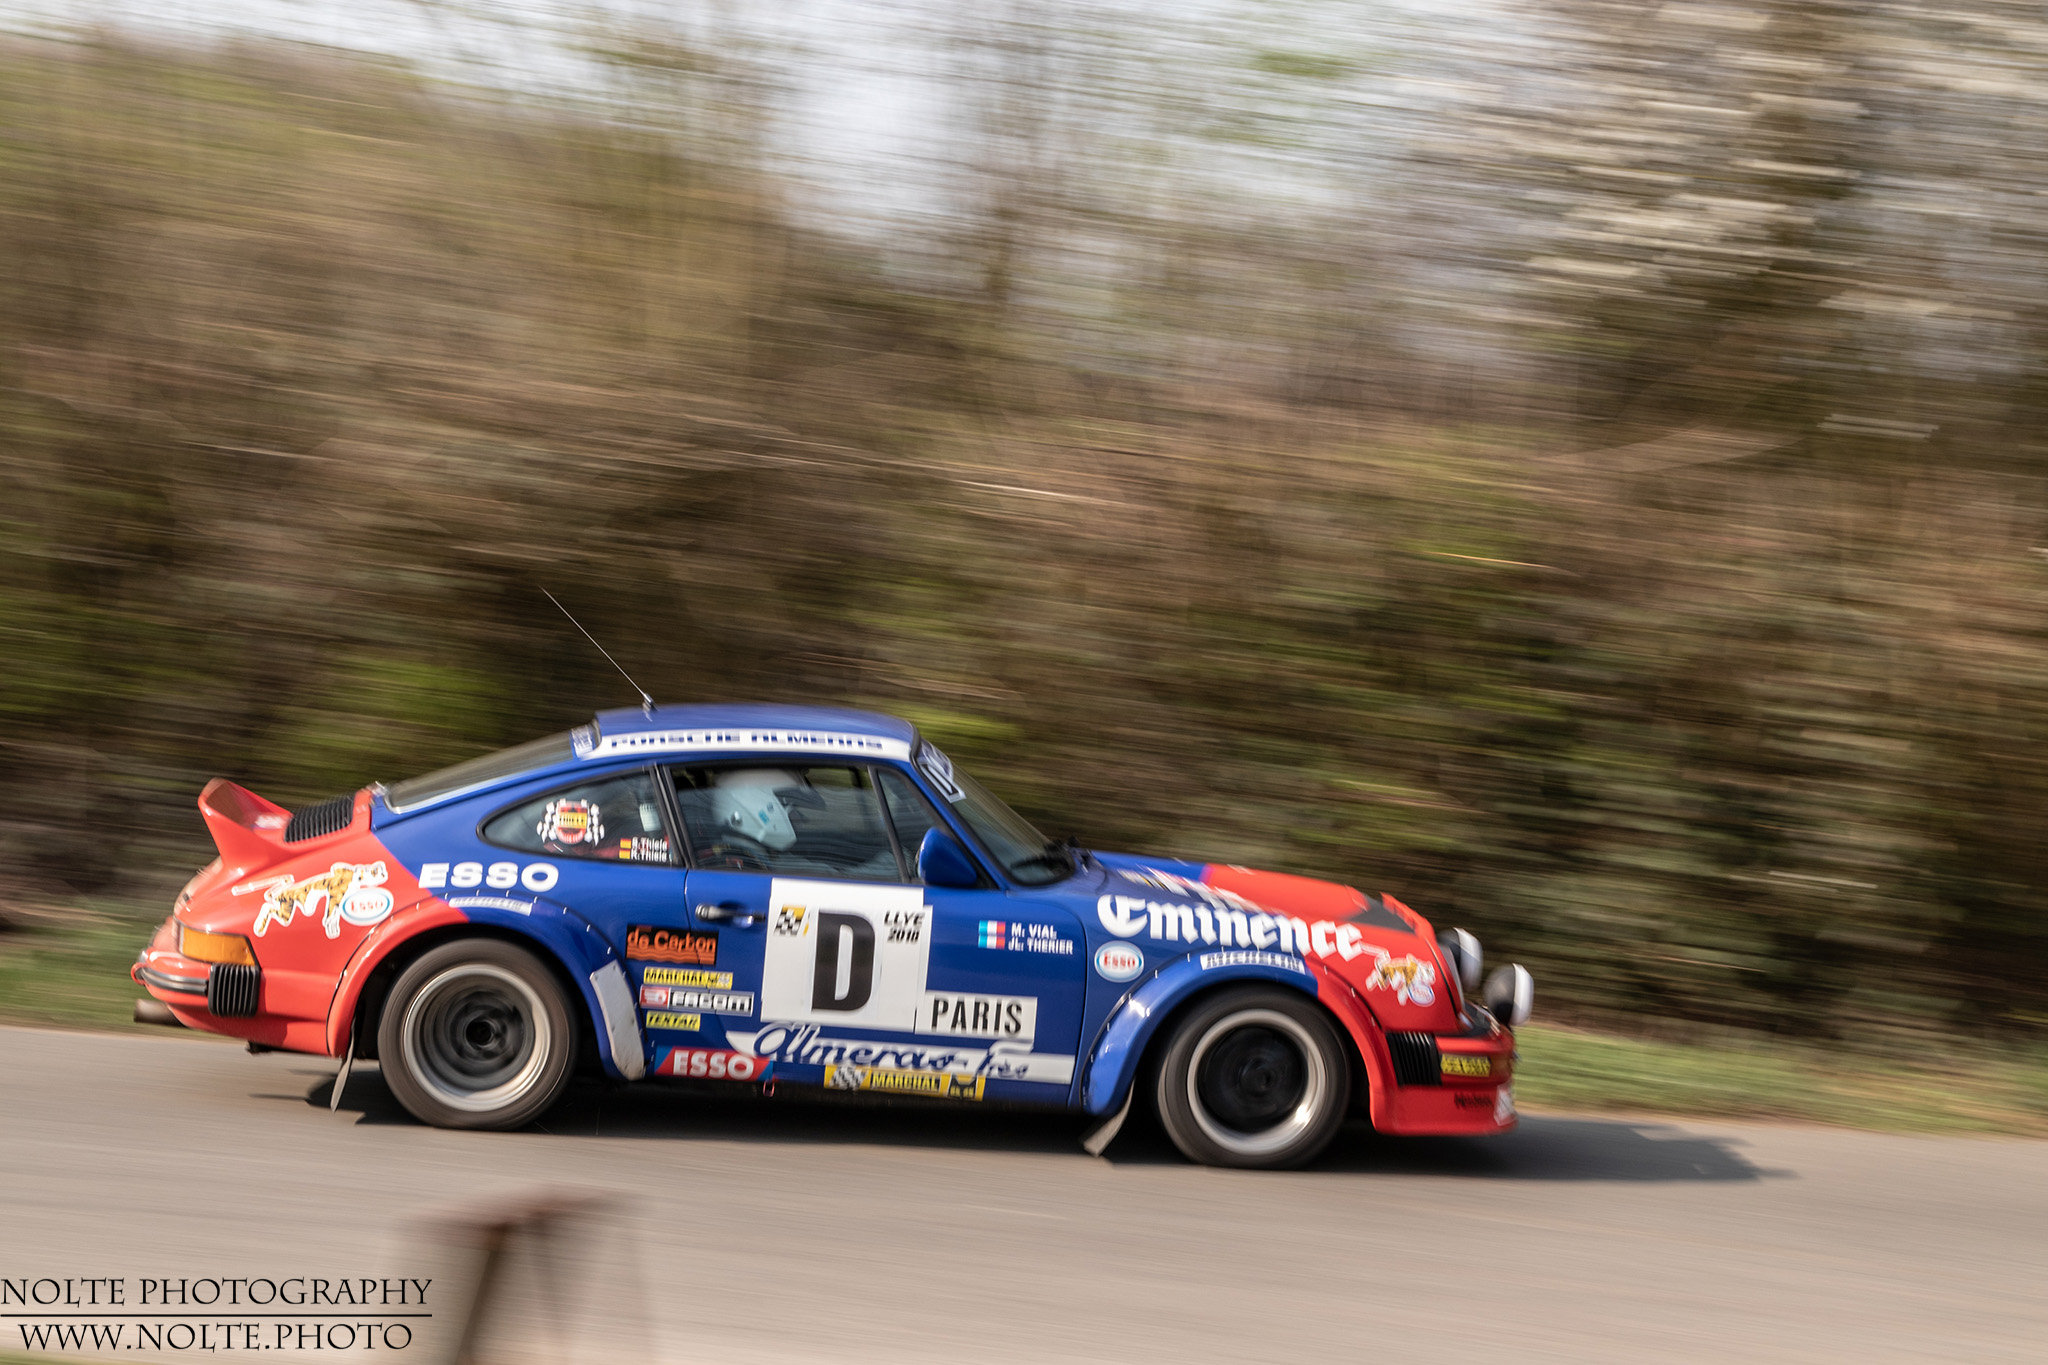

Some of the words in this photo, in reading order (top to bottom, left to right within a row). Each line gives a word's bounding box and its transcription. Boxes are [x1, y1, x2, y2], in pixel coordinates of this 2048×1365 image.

[419, 862, 559, 892] ESSO
[1029, 923, 1057, 940] VIAL
[1097, 894, 1362, 962] Eminence
[654, 930, 717, 953] Carbon
[811, 911, 876, 1012] D
[645, 968, 704, 987] MARCHAL
[672, 991, 752, 1012] FACOM
[931, 998, 1023, 1035] PARIS
[673, 1050, 755, 1080] ESSO
[871, 1072, 941, 1092] MARCHAL
